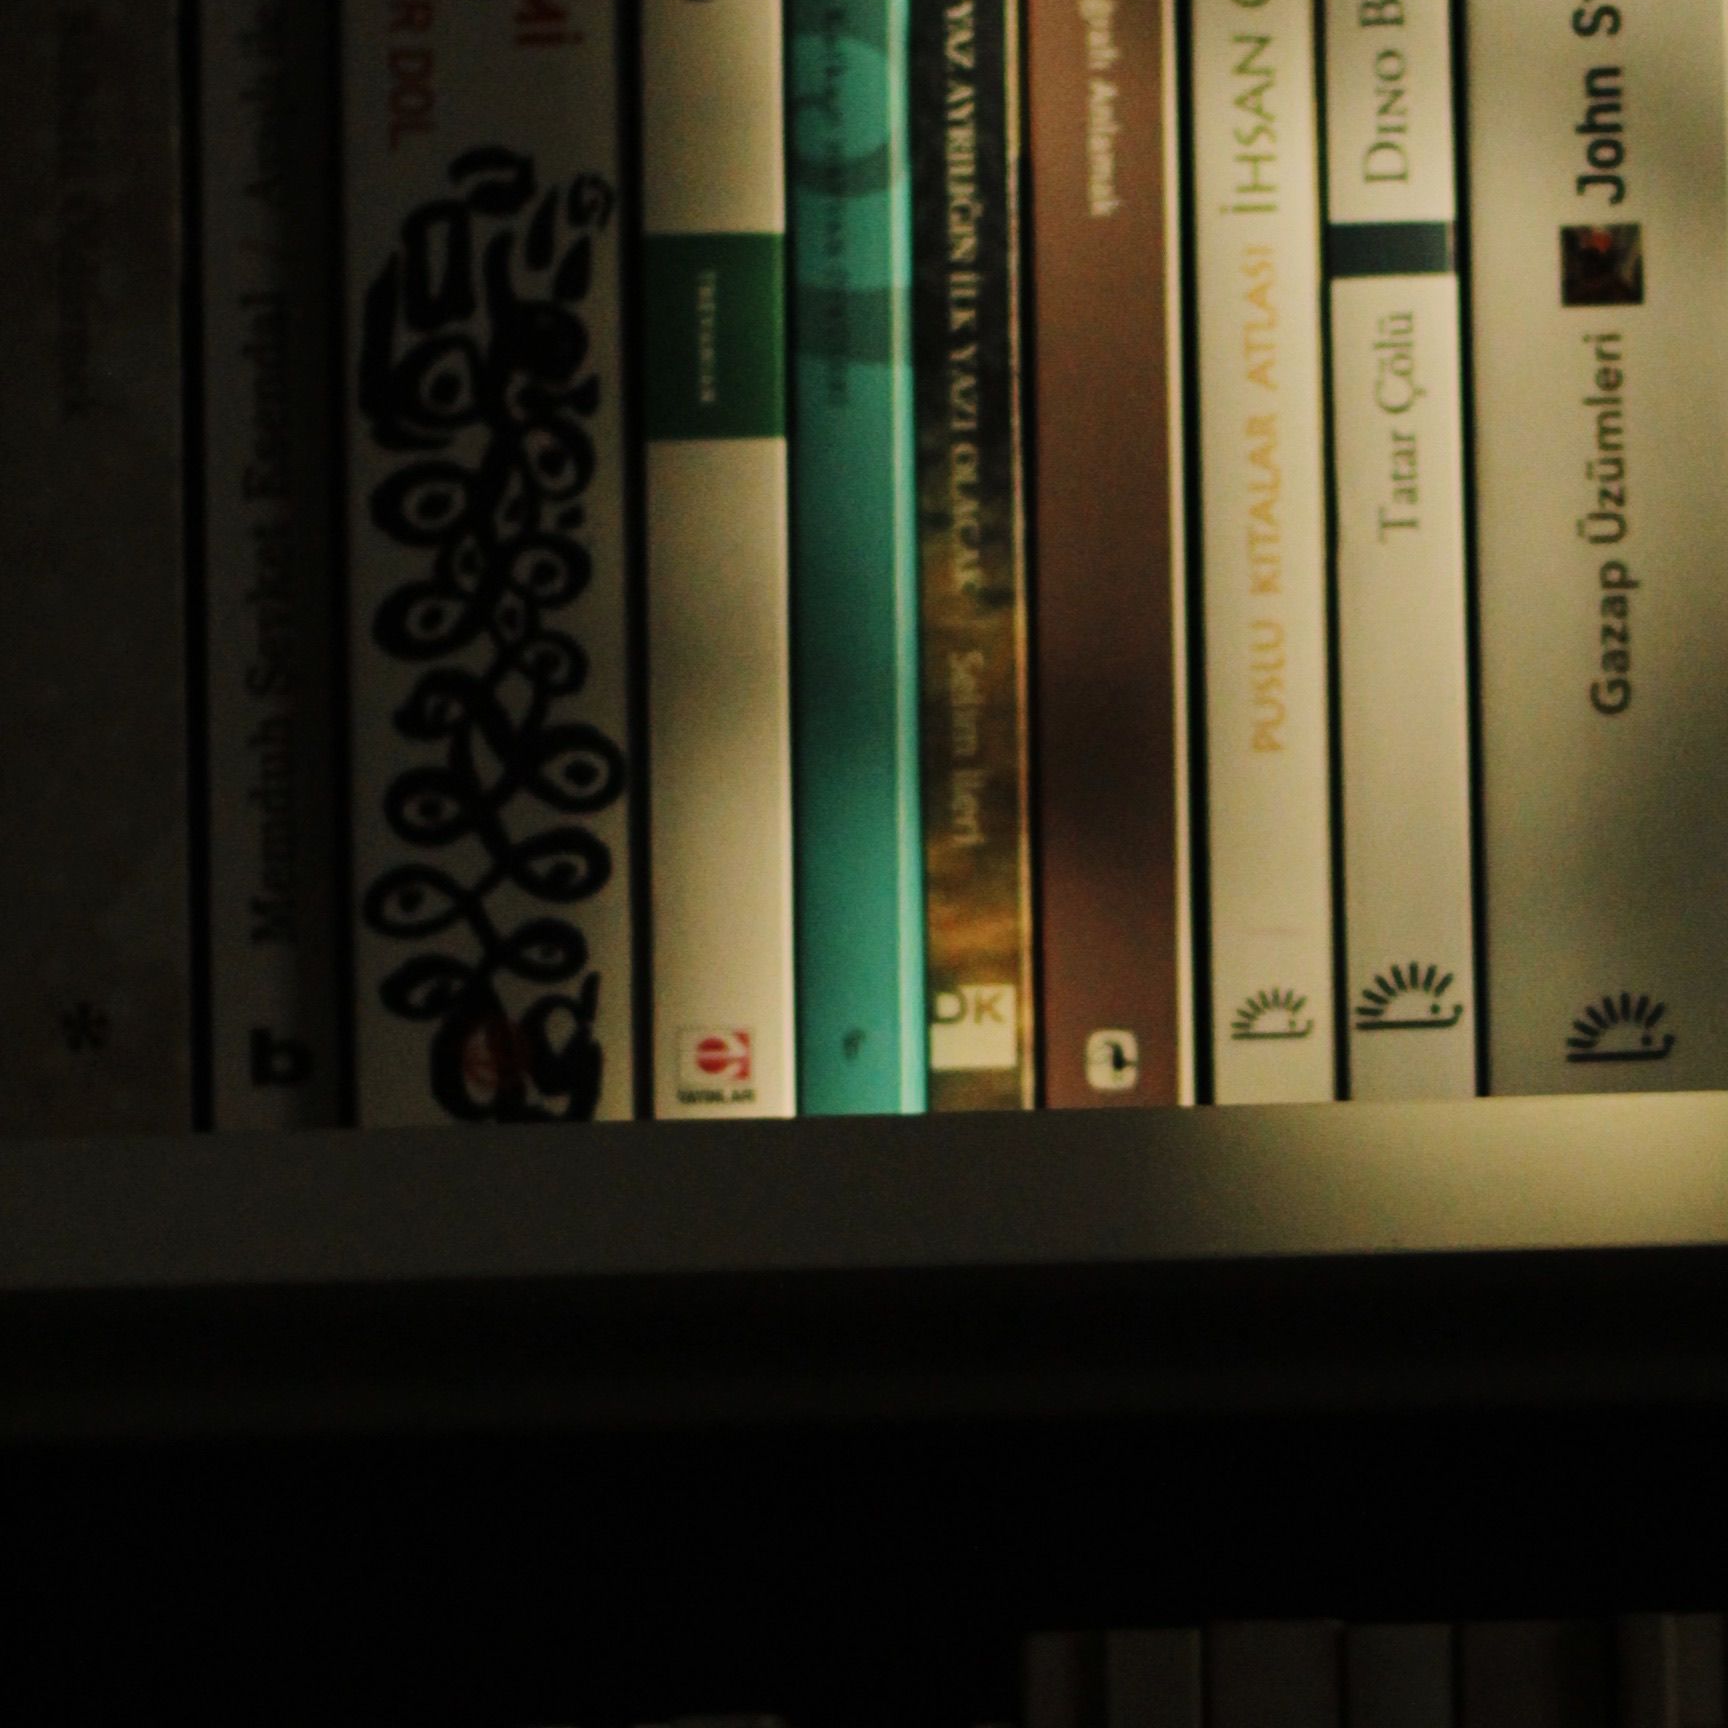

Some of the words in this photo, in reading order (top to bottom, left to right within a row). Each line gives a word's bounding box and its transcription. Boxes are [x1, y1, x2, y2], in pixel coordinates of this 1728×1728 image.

[1219, 34, 1276, 218] İHSAN
[1574, 64, 1629, 205] John
[948, 342, 980, 430] YAZI
[1575, 329, 1632, 546] Üzümleri
[947, 441, 985, 596] OLACAK
[1248, 414, 1283, 593] KITALAR
[1376, 431, 1420, 546] Tatar
[1252, 623, 1286, 754] PUSLU
[1588, 560, 1641, 718] Gazap
